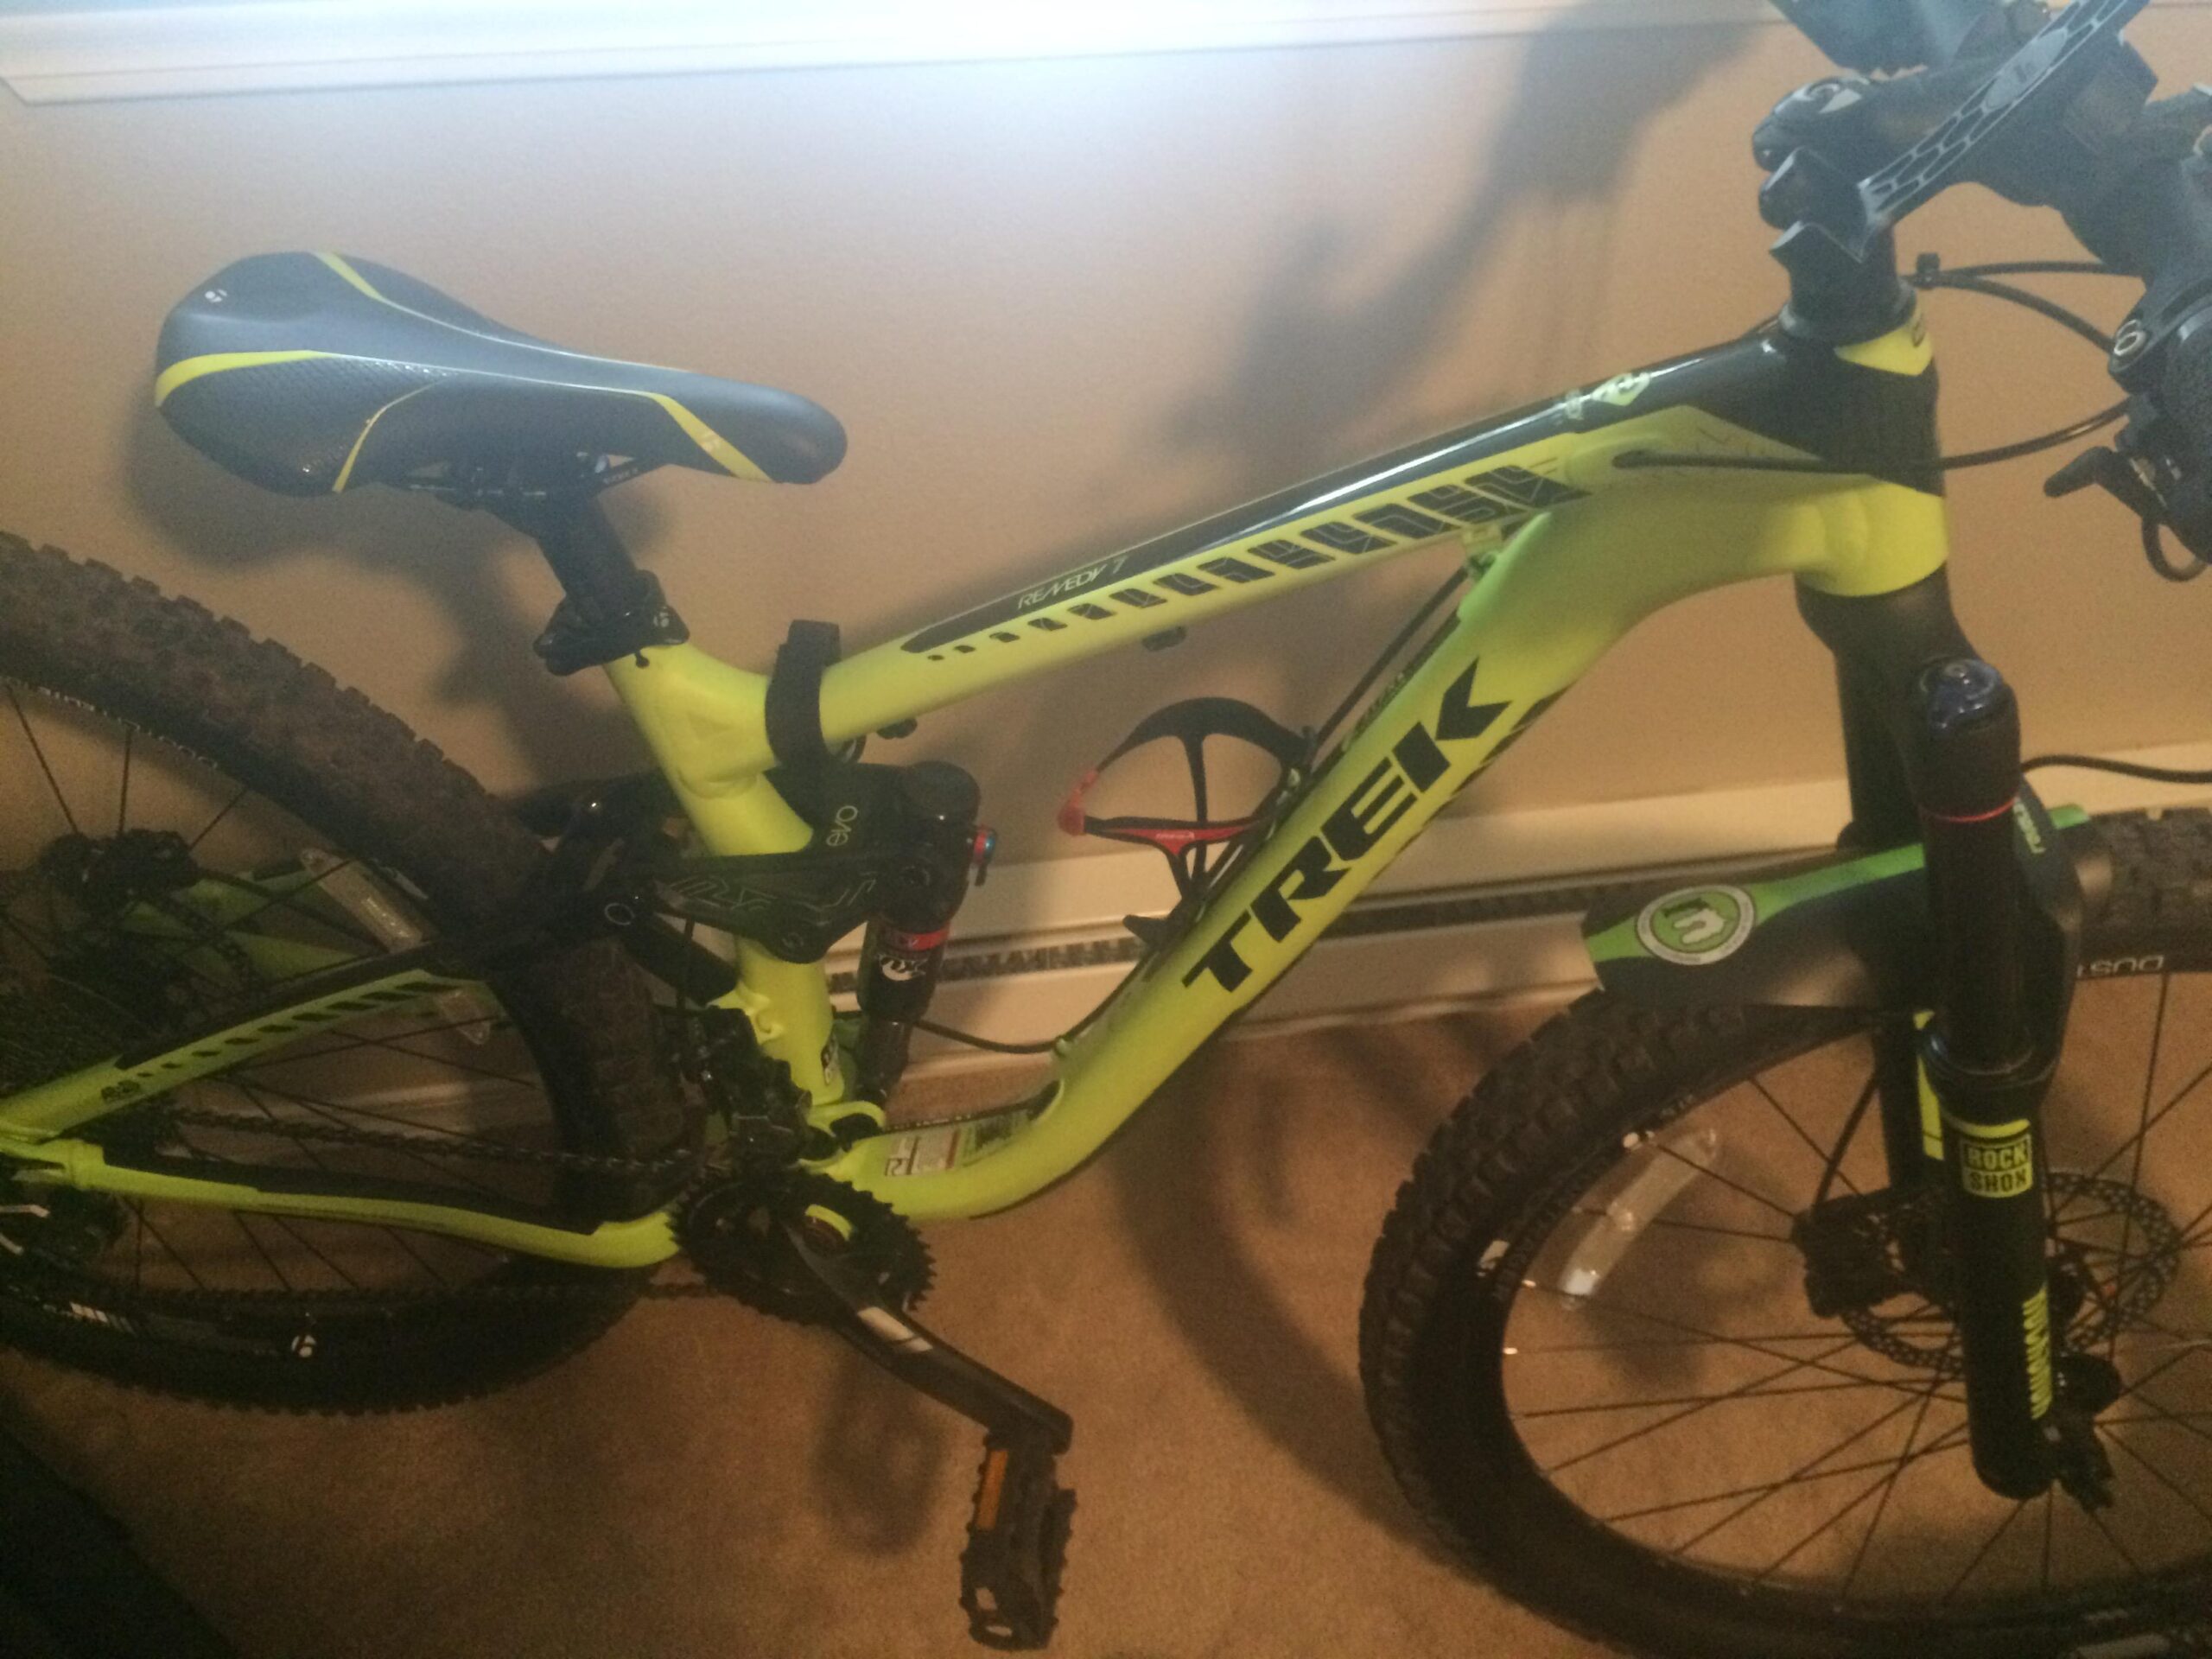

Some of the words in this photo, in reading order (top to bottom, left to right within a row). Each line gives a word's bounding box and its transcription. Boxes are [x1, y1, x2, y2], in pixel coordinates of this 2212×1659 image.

[1017, 563, 1108, 610] REMEDY
[1111, 555, 1129, 575] 7
[826, 805, 858, 846] evo
[1180, 656, 1513, 993] TREK
[1967, 1141, 2027, 1170] ROCK
